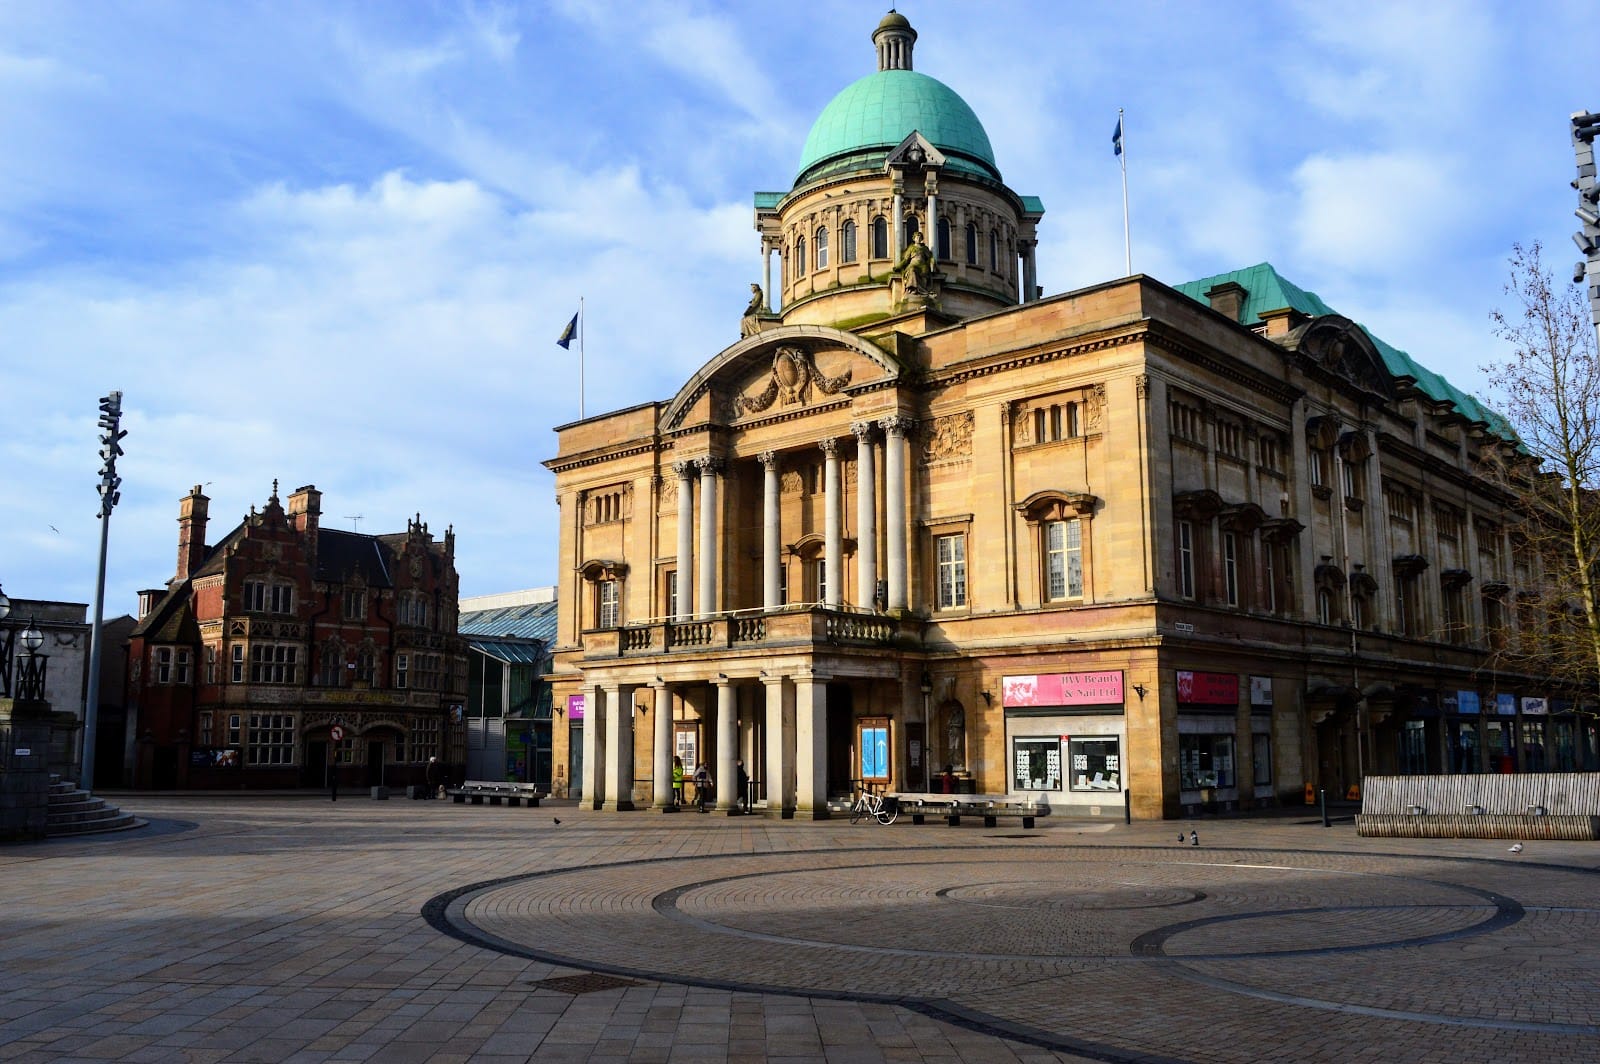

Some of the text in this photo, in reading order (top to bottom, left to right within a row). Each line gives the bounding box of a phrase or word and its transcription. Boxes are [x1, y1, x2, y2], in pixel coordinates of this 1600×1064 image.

[1085, 675, 1118, 683] Beauty
[1065, 689, 1073, 697] &
[1077, 688, 1096, 696] Nail
